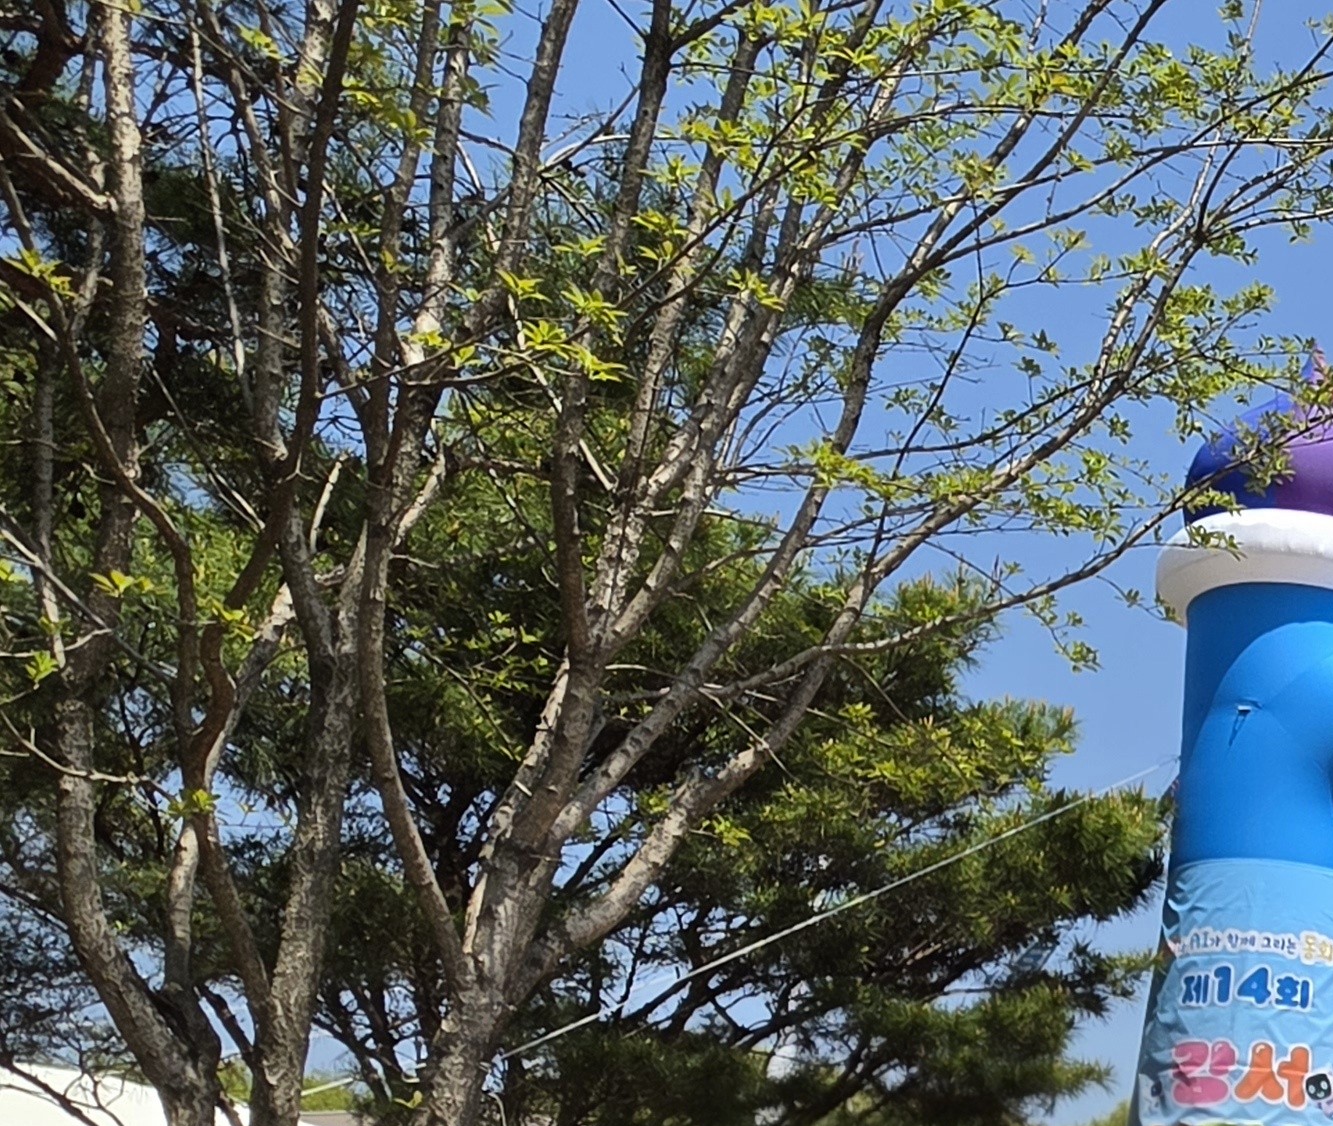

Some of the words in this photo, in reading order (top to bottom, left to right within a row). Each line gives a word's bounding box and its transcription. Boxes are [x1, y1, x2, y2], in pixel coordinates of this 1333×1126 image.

[1261, 936, 1297, 955] 그리는
[1181, 966, 1311, 1009] 제14회
[1173, 1040, 1310, 1108] 강서
